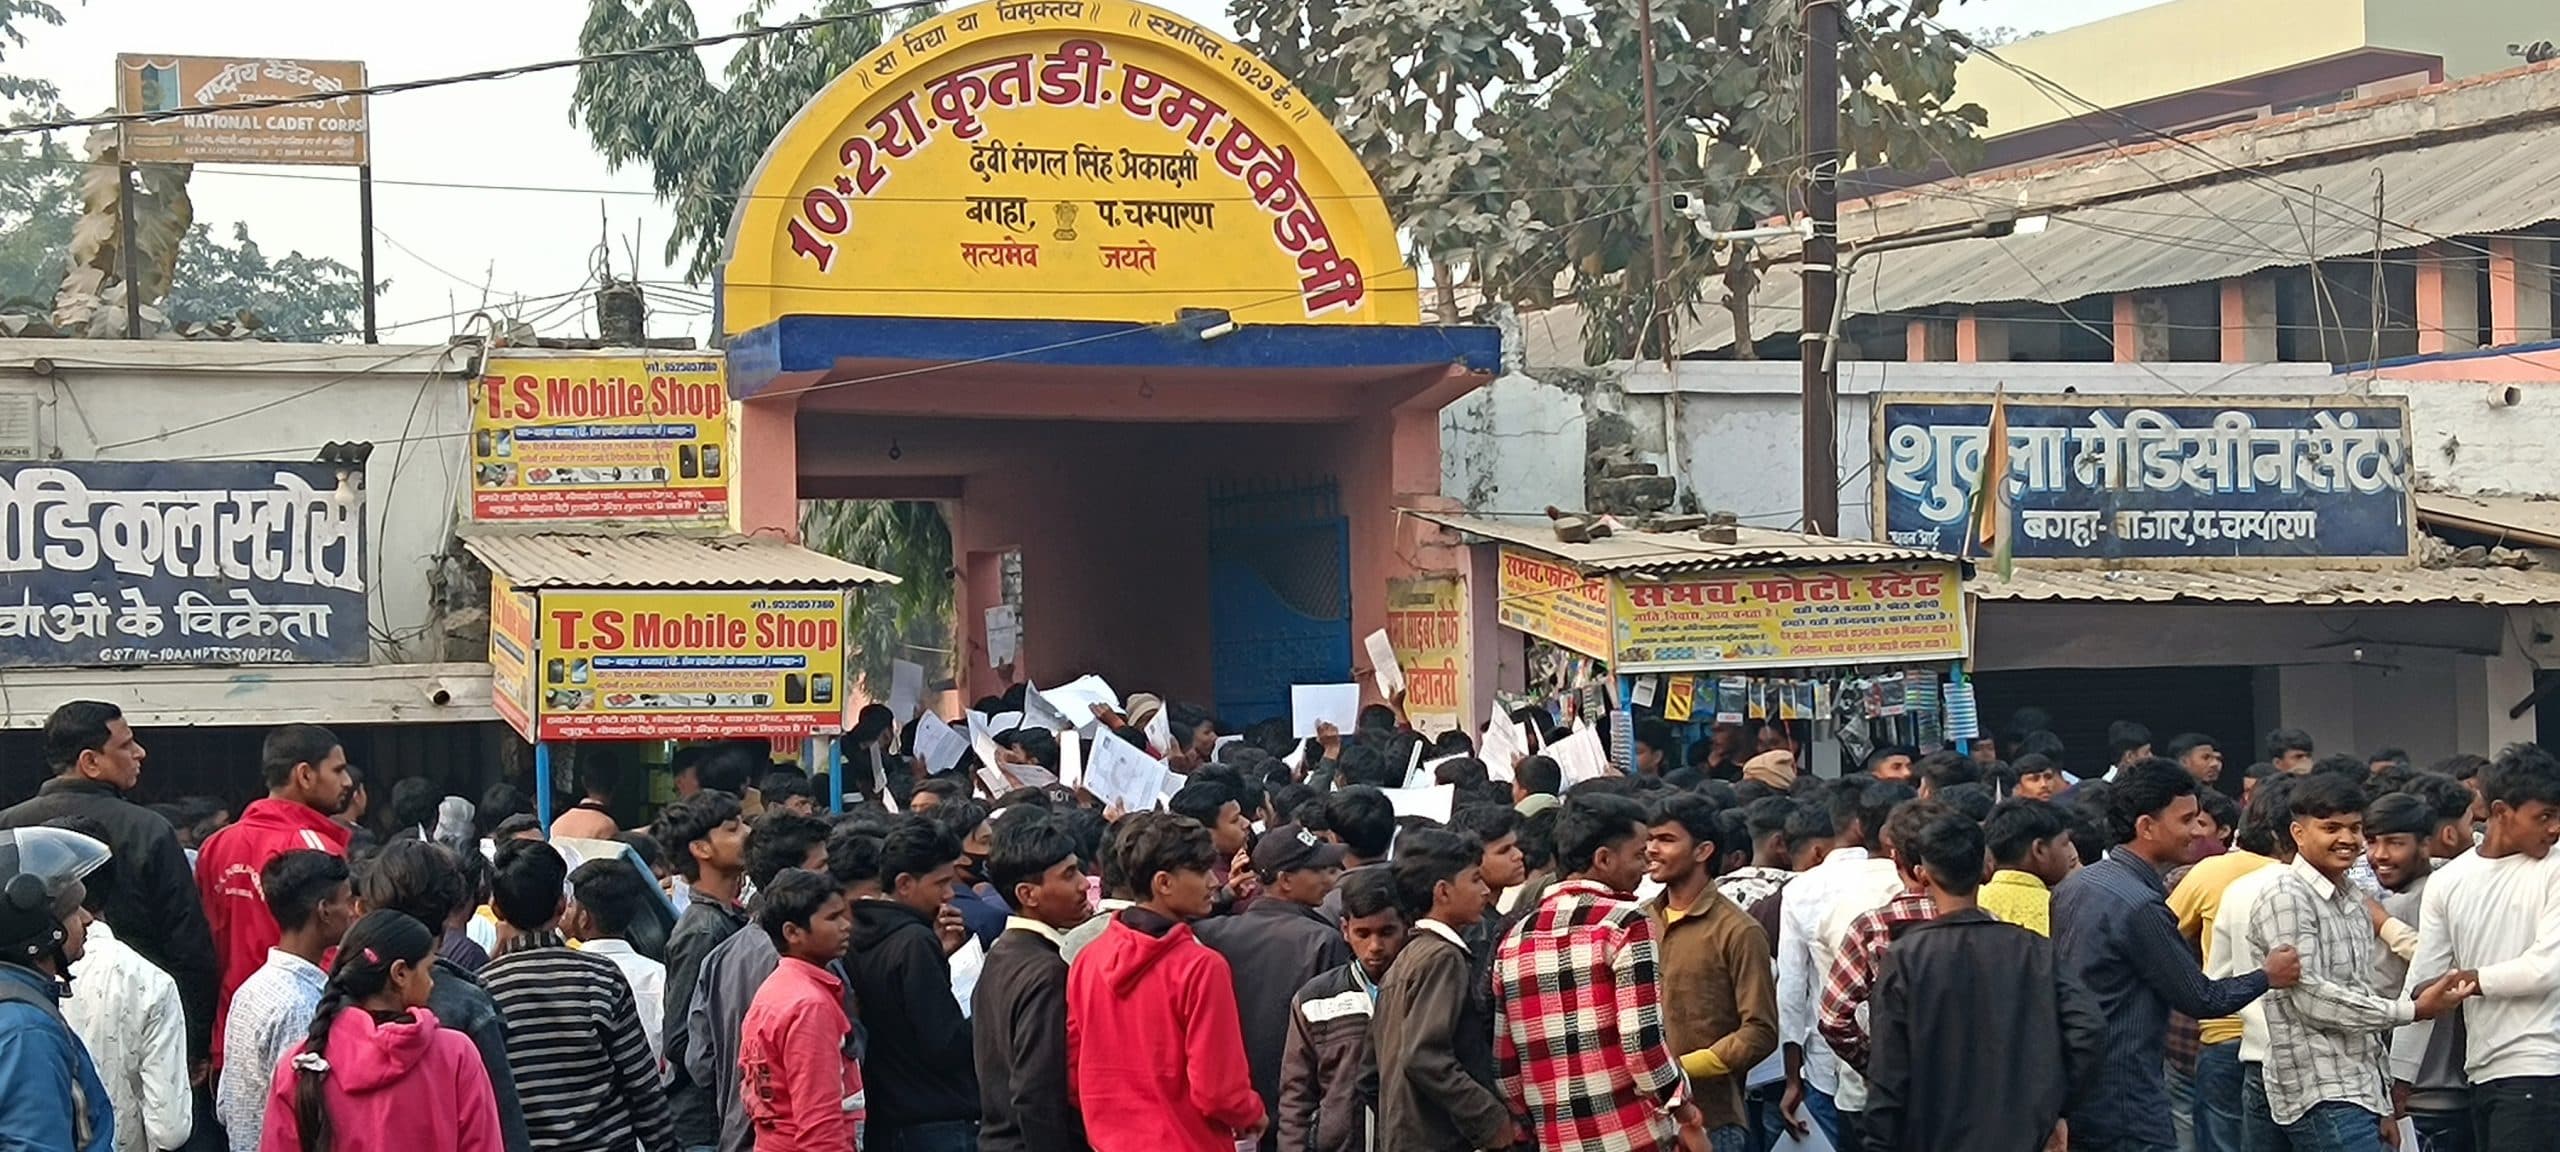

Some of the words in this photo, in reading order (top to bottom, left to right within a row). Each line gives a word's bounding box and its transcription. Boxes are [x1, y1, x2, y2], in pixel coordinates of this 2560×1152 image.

[903, 25, 948, 57] विद्या
[957, 13, 978, 32] या
[184, 114, 261, 129] NATIONAL
[266, 116, 315, 131] CADET
[318, 118, 364, 132] CORPS
[1012, 142, 1069, 181] मंगल
[1073, 143, 1115, 184] सिंह
[1116, 147, 1199, 188] अकादमी
[960, 236, 1039, 273] सत्यमेव
[1099, 239, 1157, 276] जयते
[482, 374, 540, 420] T.S
[546, 377, 645, 418] Mobile
[650, 376, 722, 420] Shop
[2071, 410, 2296, 493] मेडिसीन
[1747, 571, 1853, 604] फोटो
[116, 587, 165, 637] के
[173, 587, 333, 645] विक्रेता
[552, 609, 625, 651] T.S
[633, 612, 747, 650] Mobile
[756, 612, 838, 651] Shop
